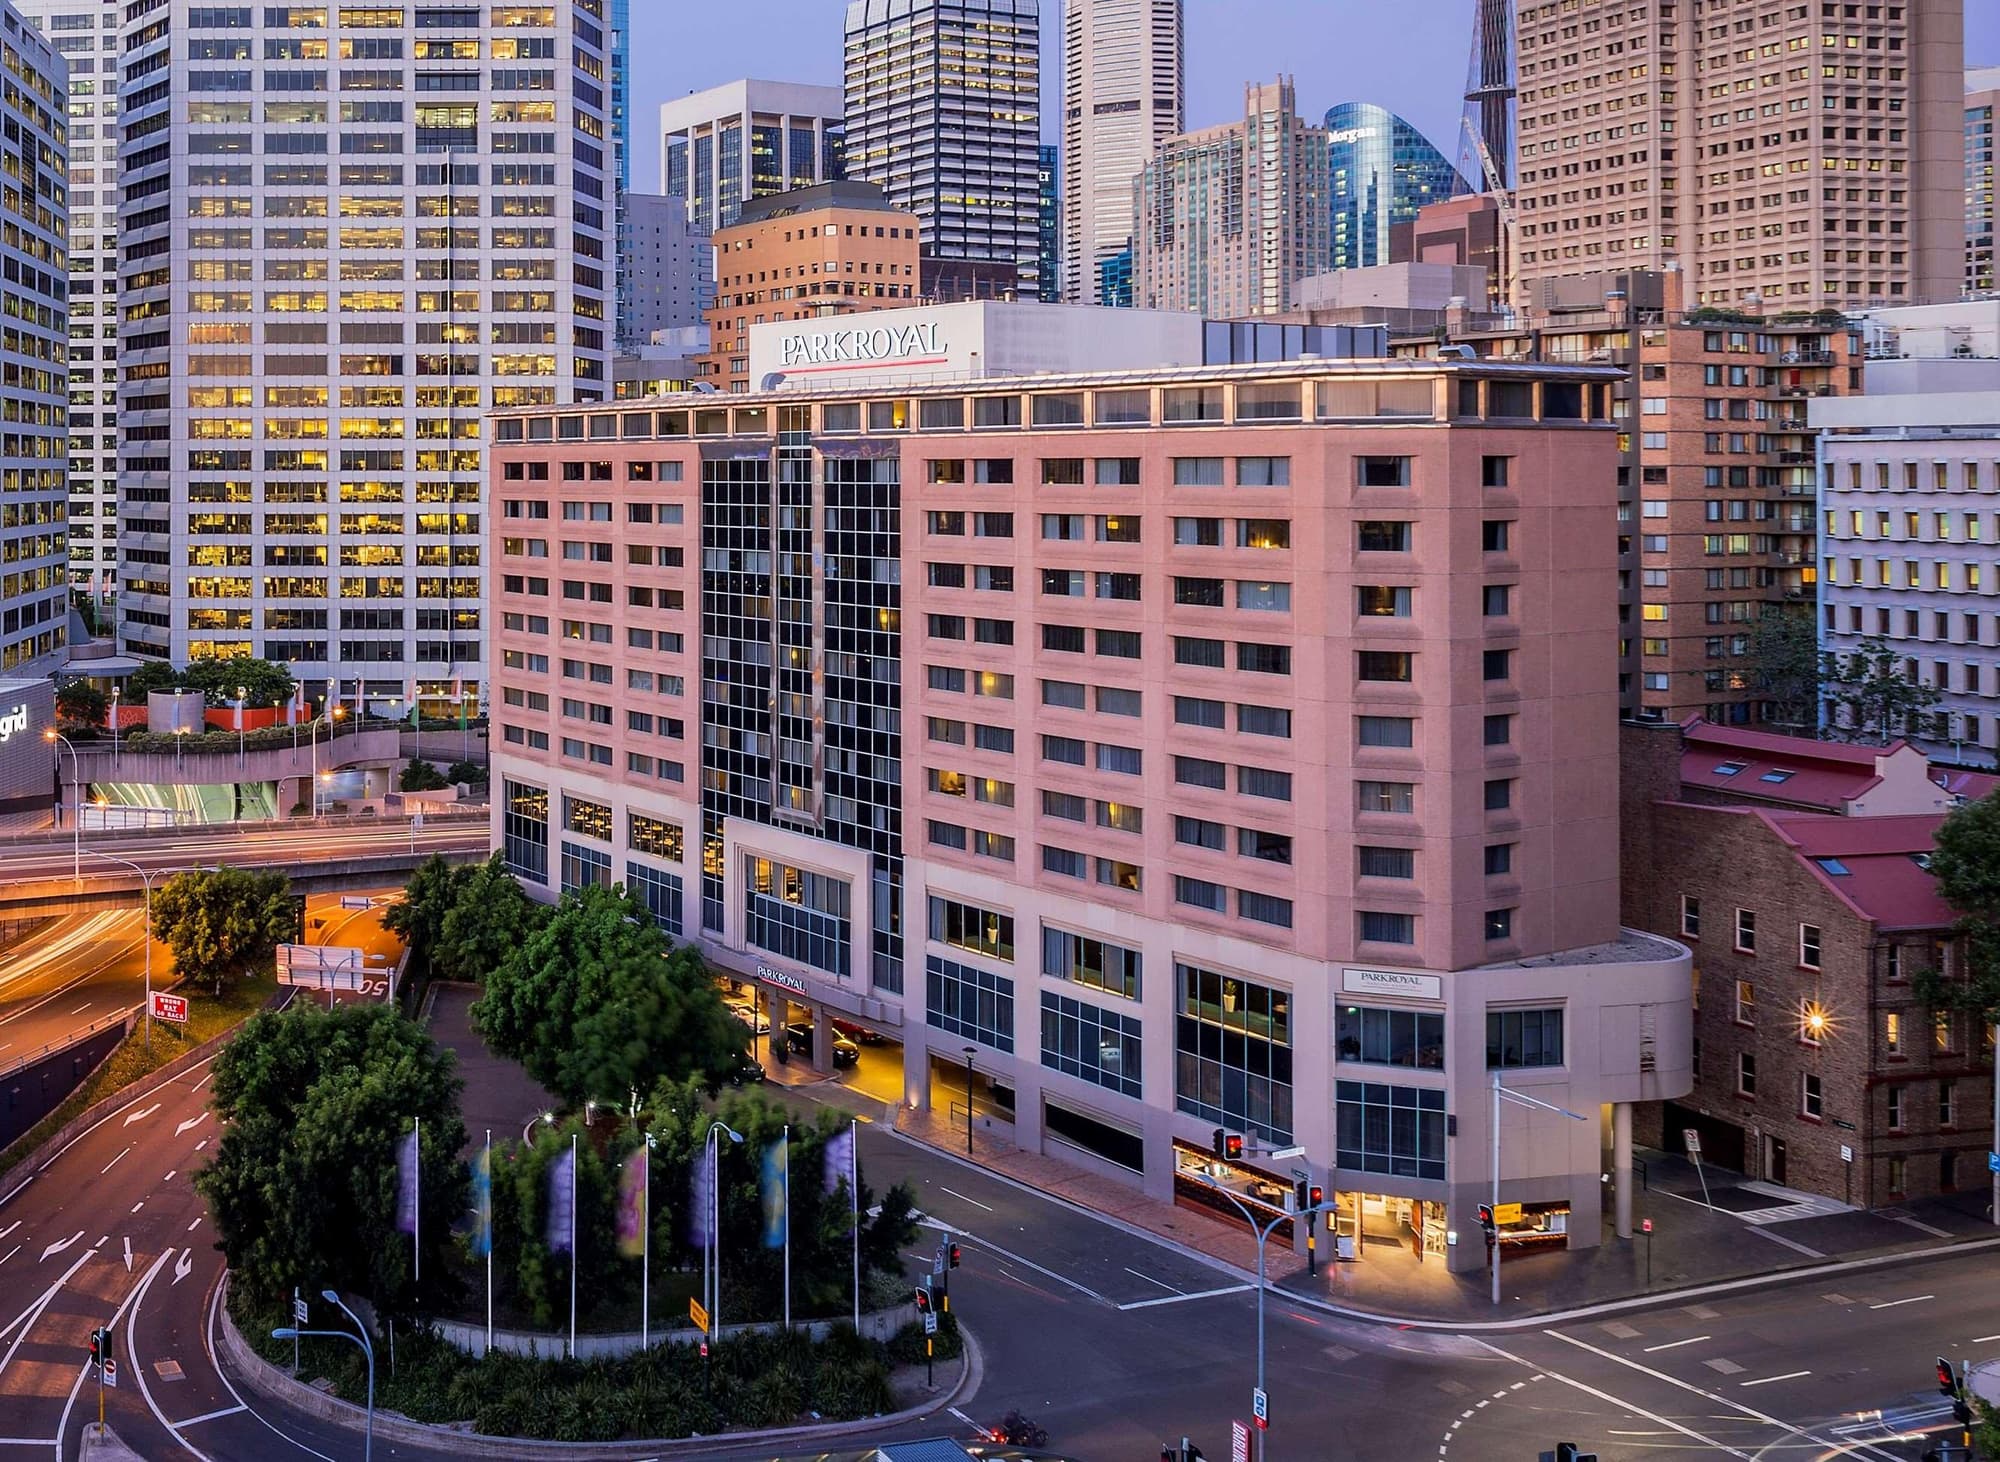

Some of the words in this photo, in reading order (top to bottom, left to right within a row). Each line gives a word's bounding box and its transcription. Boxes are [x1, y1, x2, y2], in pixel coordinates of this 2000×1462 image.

[1328, 127, 1376, 144] Morgan
[779, 322, 949, 367] PARKROYAL
[757, 965, 807, 993] PARKROYAL
[1360, 972, 1423, 986] PARKROYAL
